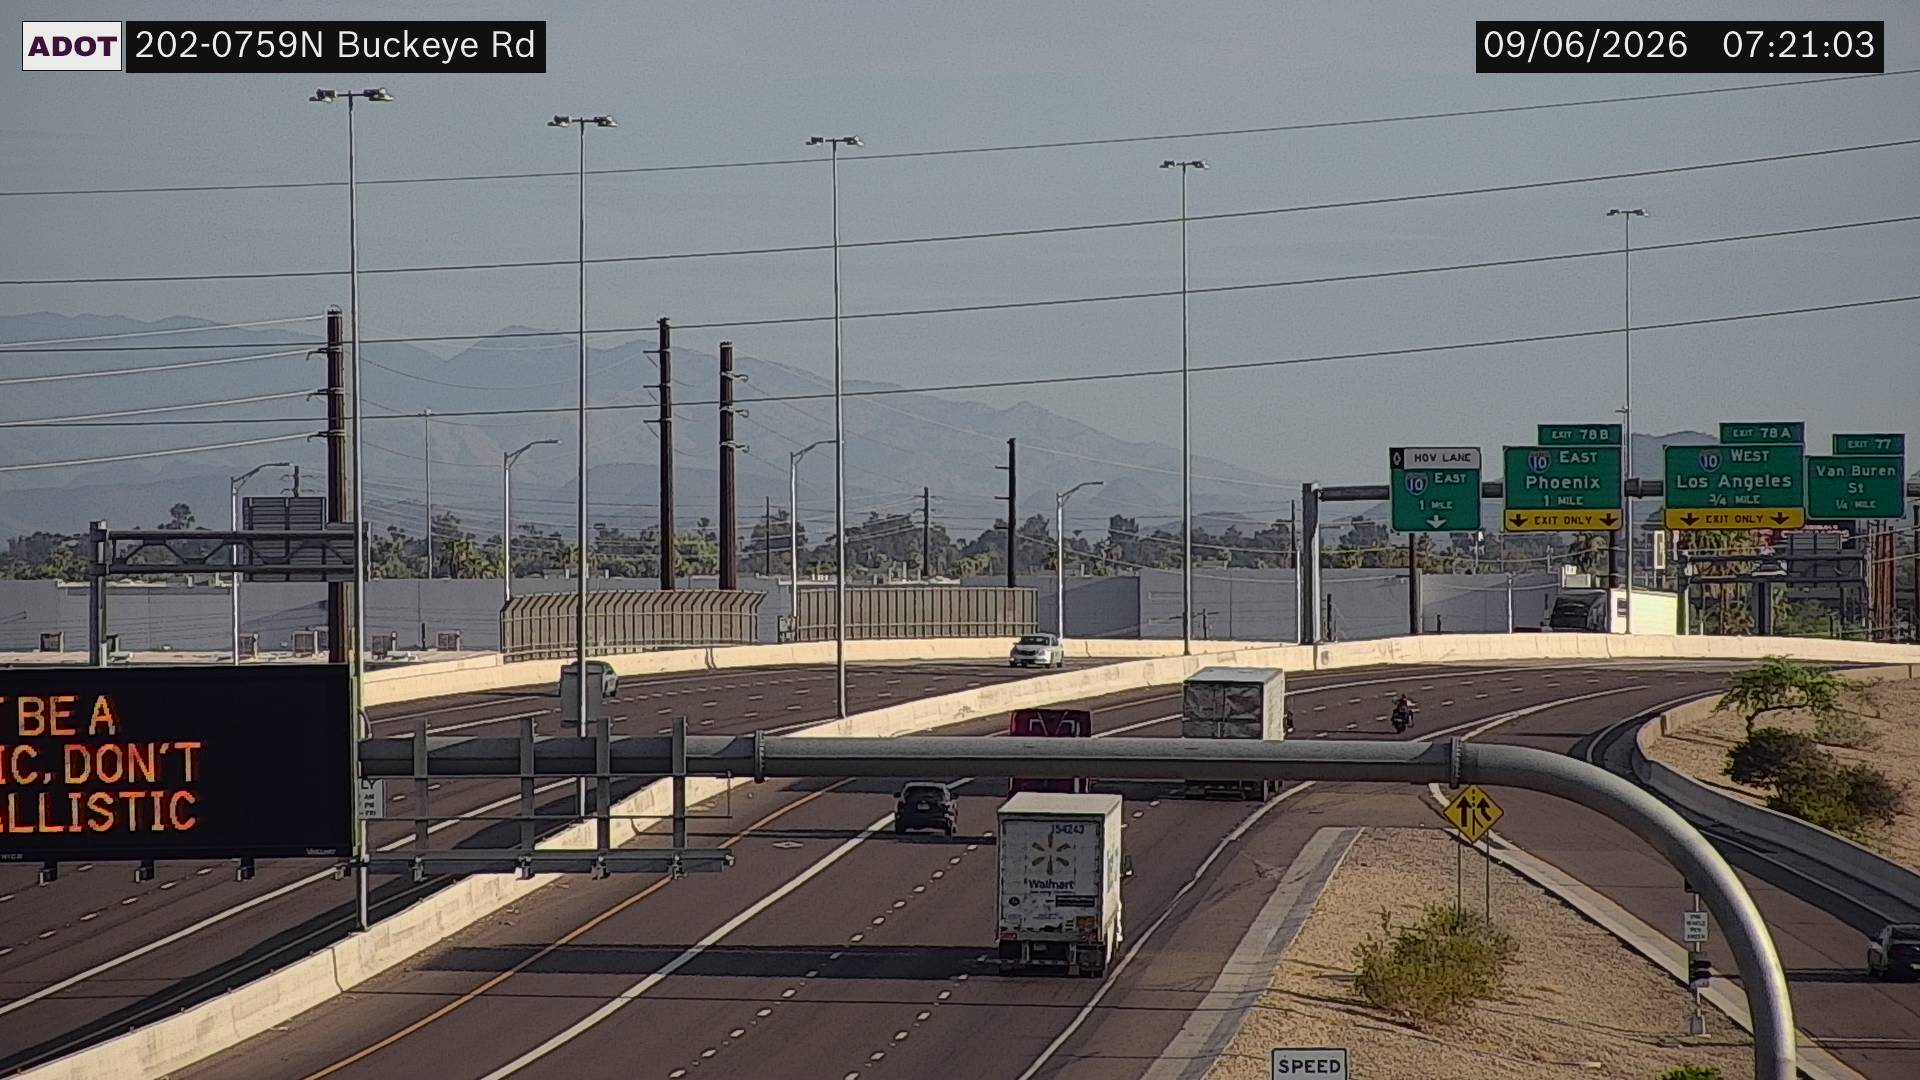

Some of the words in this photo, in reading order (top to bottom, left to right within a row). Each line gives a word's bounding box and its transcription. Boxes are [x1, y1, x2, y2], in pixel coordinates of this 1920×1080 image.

[1875, 438, 1892, 449] 77
[1414, 453, 1437, 463] HOV
[1442, 453, 1471, 462] LANE
[1533, 455, 1548, 468] 10
[1559, 451, 1598, 463] EAST
[1703, 454, 1719, 467] 10
[1730, 449, 1770, 462] WEST
[1434, 472, 1467, 483] EAST
[1815, 465, 1846, 477] Van
[1851, 465, 1896, 477] Buren
[1408, 477, 1424, 490] 10
[1526, 475, 1600, 489] Phoenix
[1677, 475, 1708, 489] Los
[1718, 474, 1792, 492] Angeles
[1847, 482, 1865, 495] St
[1557, 496, 1584, 506] MILE
[1534, 515, 1558, 525] EXIT
[1563, 515, 1593, 525] ONLY
[1705, 514, 1729, 524] EXIT
[1734, 514, 1764, 524] ONLY
[18, 696, 77, 737] BE
[89, 695, 117, 736] A
[64, 741, 201, 784] DON'T
[0, 791, 197, 833] LLISTIC
[1029, 878, 1075, 890] Walmart
[1278, 1059, 1341, 1074] SPEED
